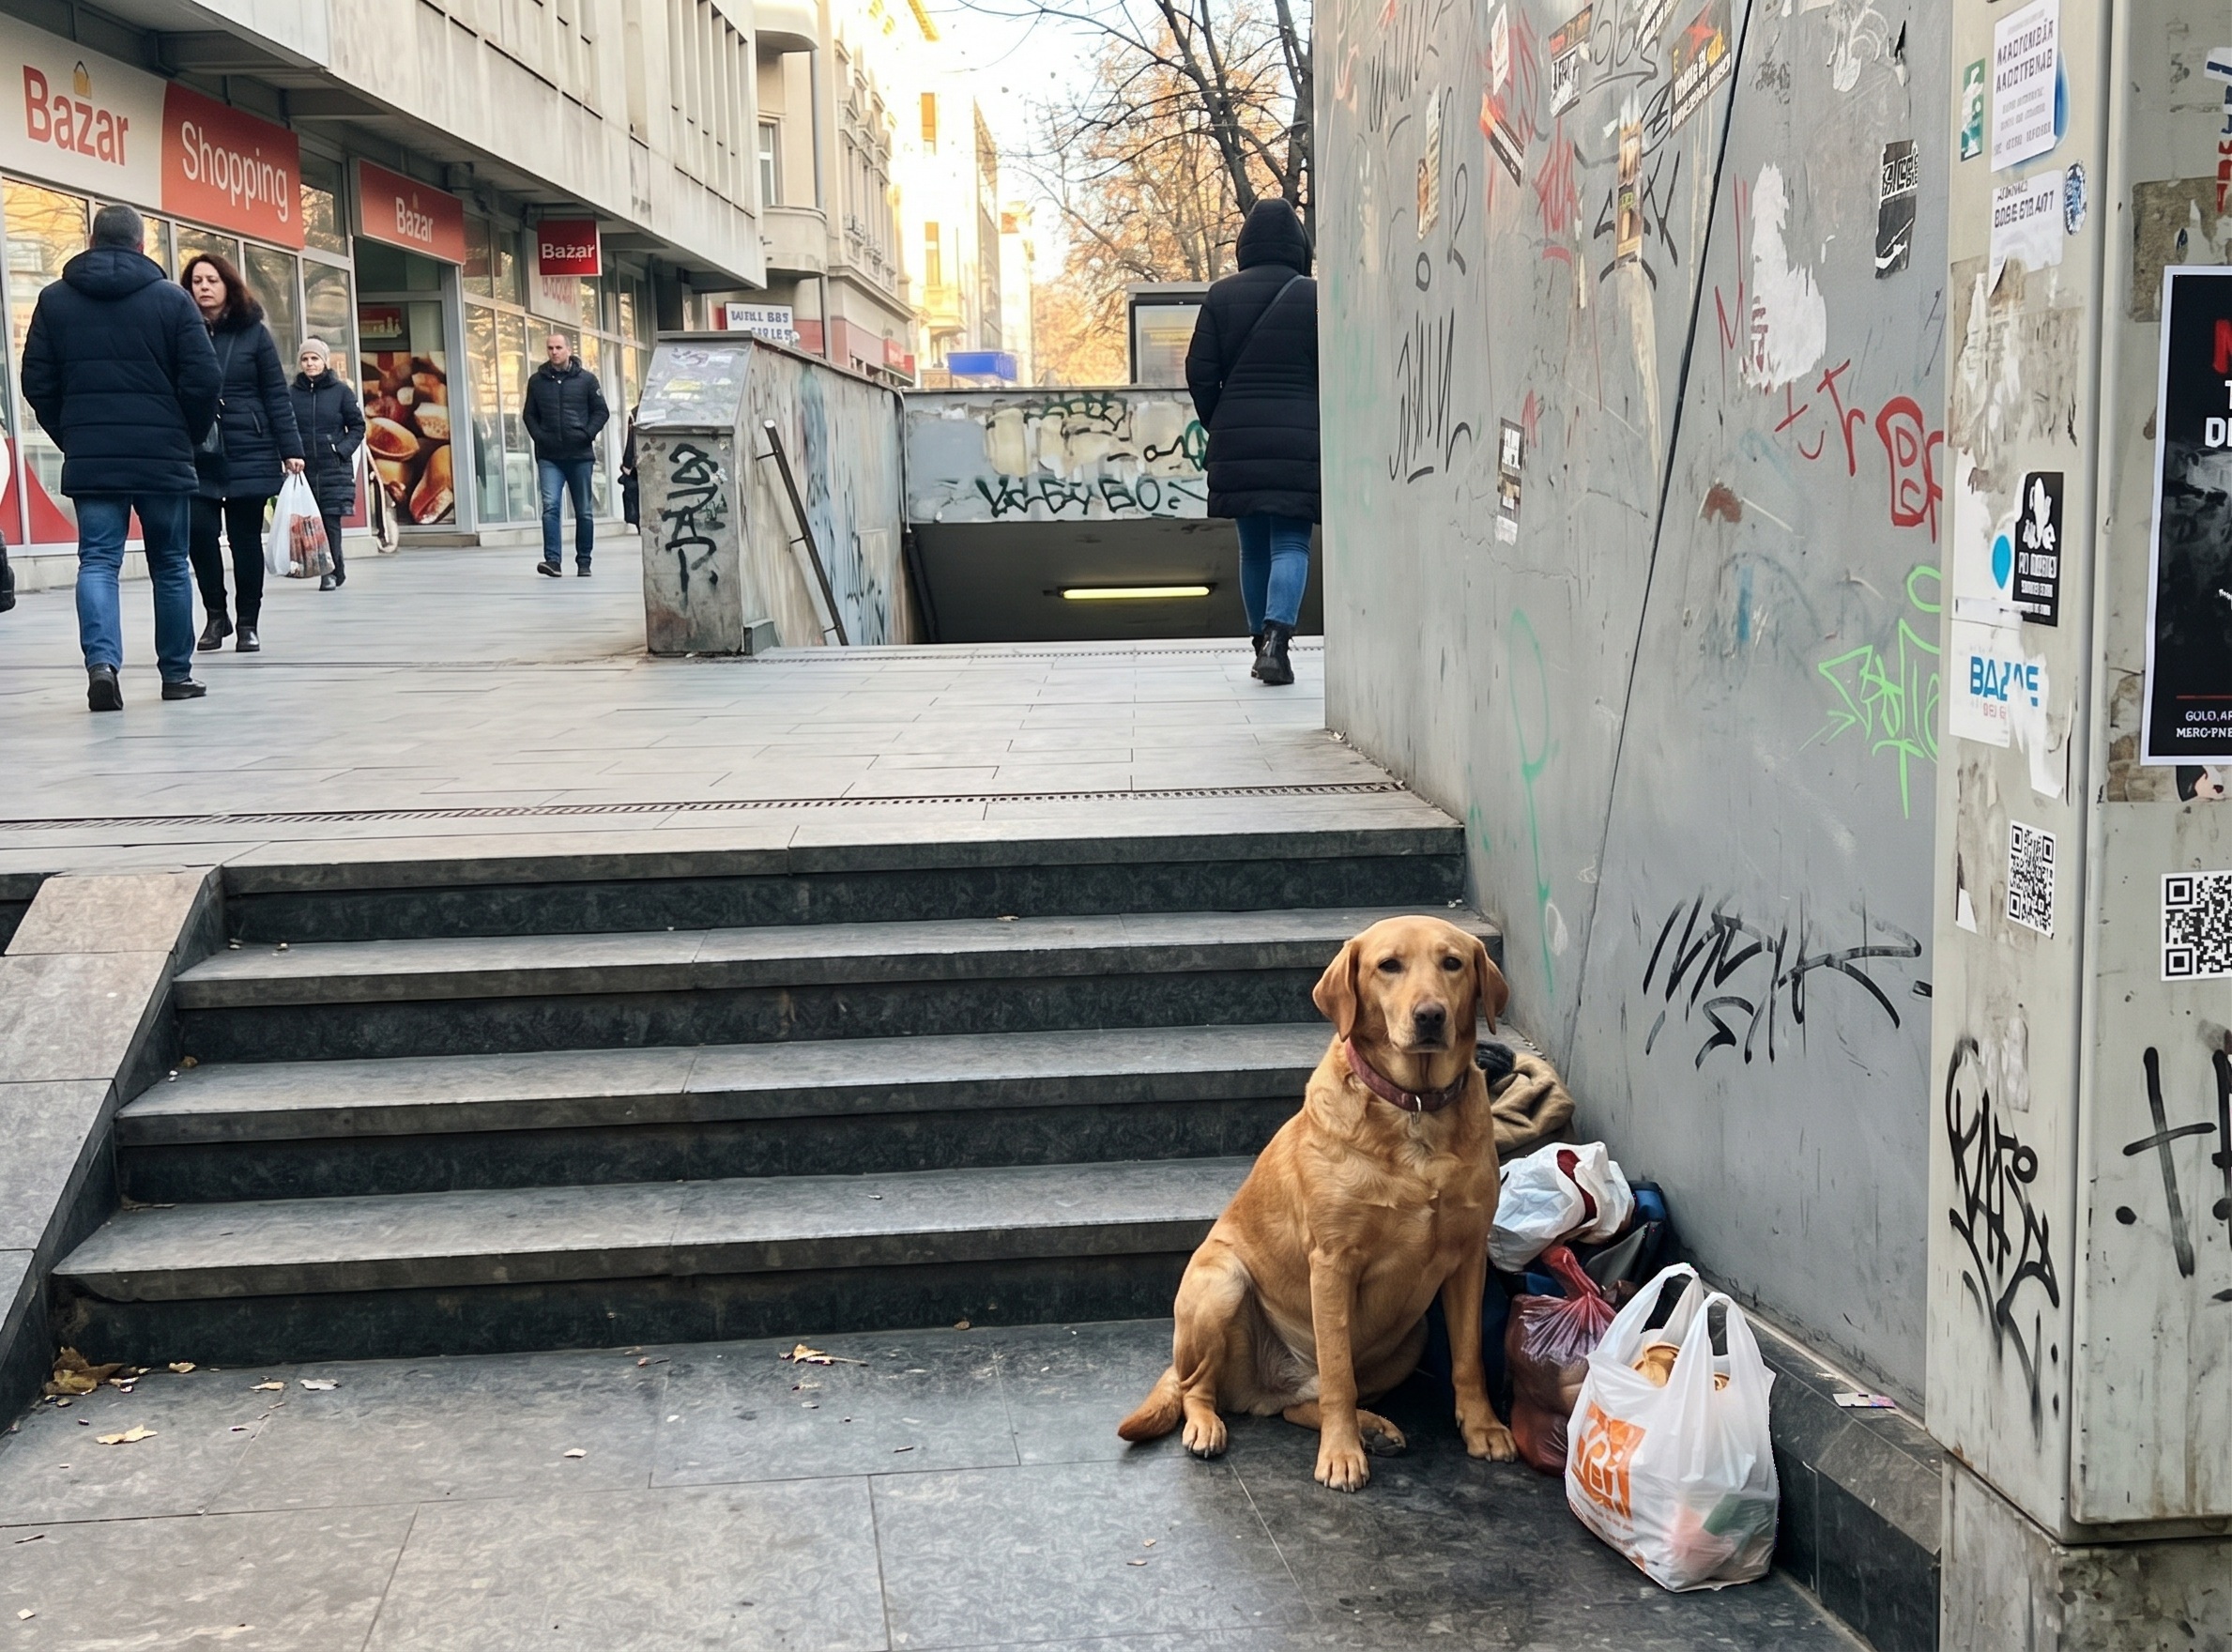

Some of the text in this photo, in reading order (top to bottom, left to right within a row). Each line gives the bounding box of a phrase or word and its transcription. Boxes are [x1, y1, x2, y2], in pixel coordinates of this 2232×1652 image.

[23, 65, 129, 166] Bazar
[181, 121, 289, 223] Shopping
[395, 197, 434, 243] Bazar
[542, 242, 595, 262] Bazar
